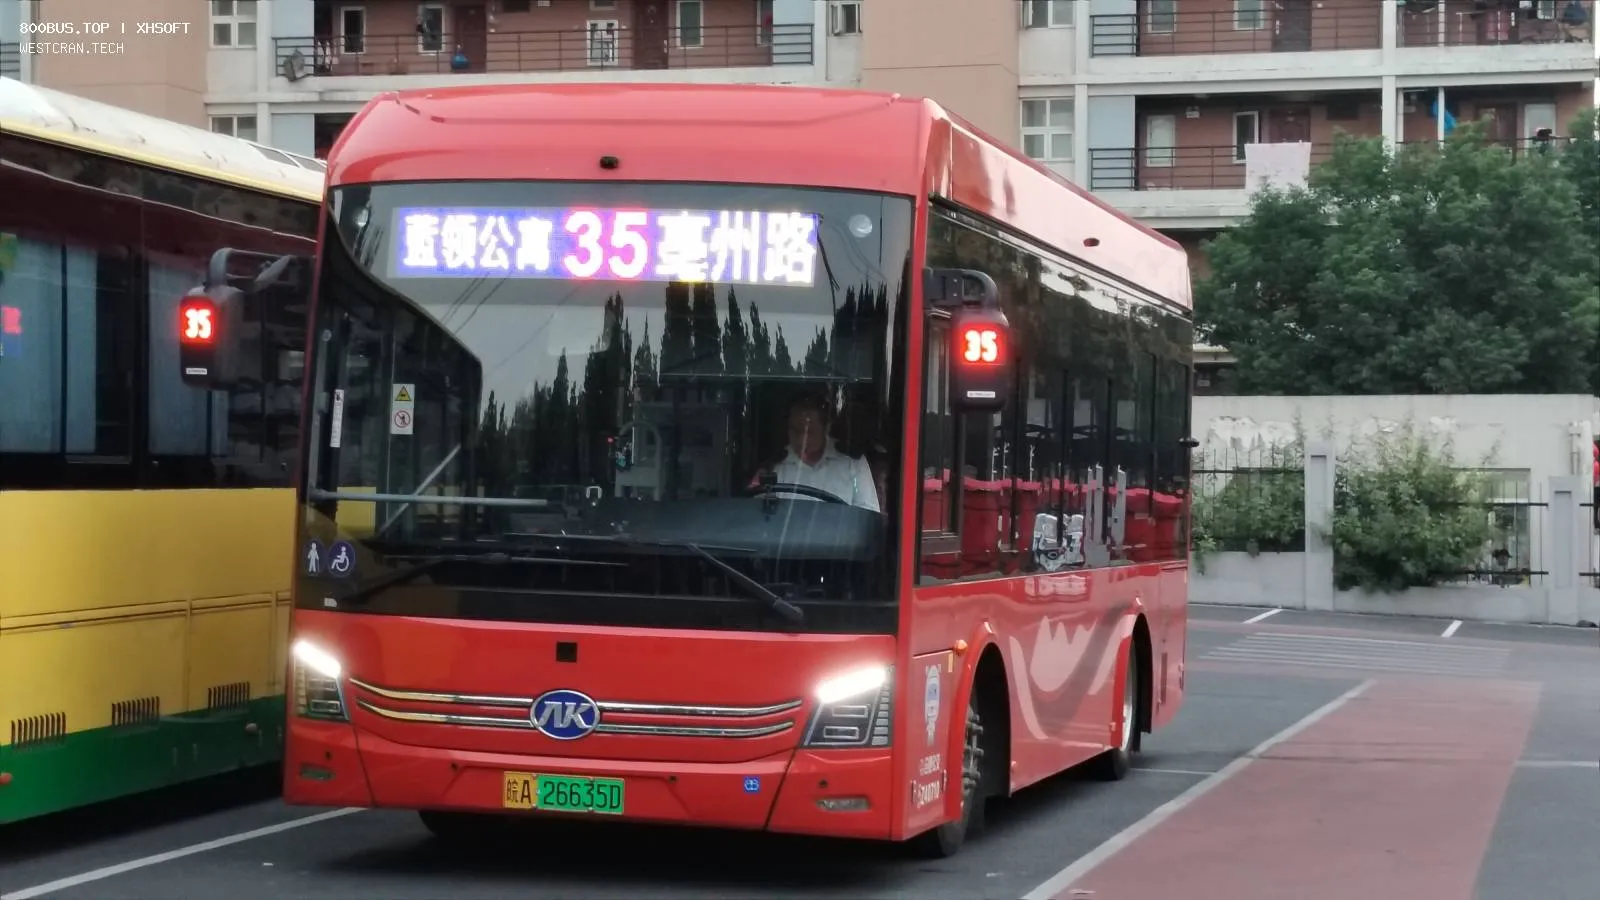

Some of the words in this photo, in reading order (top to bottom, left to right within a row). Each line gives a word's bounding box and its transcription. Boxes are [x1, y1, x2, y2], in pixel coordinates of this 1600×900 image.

[403, 214, 553, 271] 蓝领公寓
[563, 210, 649, 279] 35
[185, 308, 212, 339] 35
[964, 329, 998, 363] 35
[543, 780, 621, 809] 26635D
